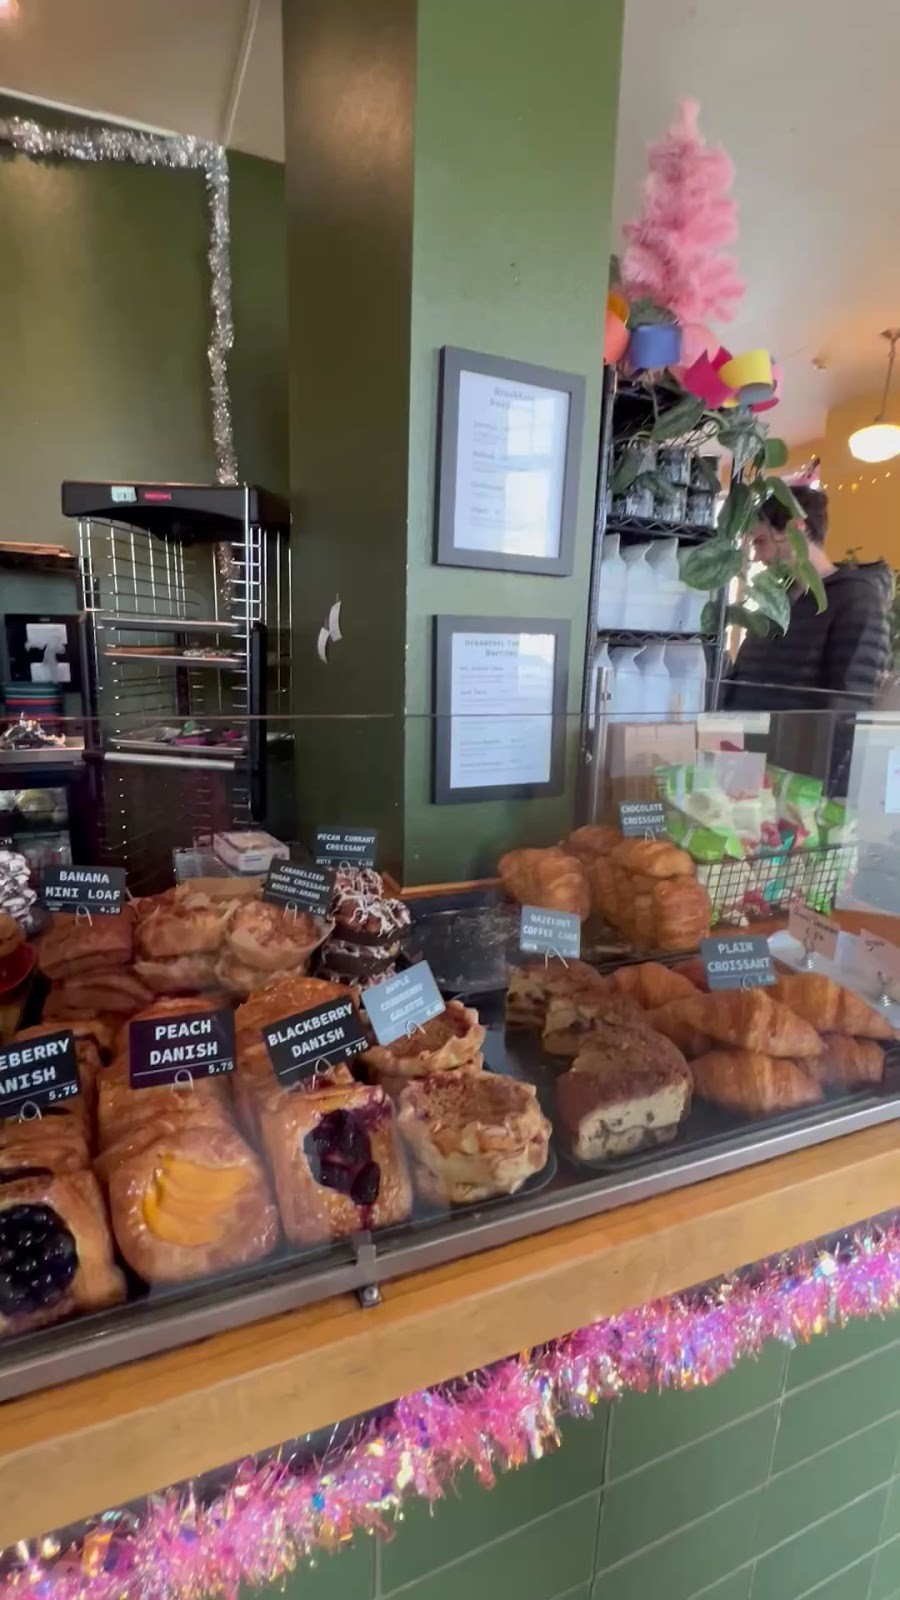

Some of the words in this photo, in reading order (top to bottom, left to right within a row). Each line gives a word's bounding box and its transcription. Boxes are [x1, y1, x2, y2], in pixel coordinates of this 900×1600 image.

[621, 803, 664, 814] CHOCOLATE
[623, 814, 666, 826] CROISSANT
[317, 833, 340, 841] PECAN
[325, 843, 367, 852] CROISSANT
[59, 870, 110, 884] BANANA
[45, 886, 79, 899] MINI
[87, 889, 121, 901] LOAF
[717, 941, 754, 954] PLAIN
[707, 957, 770, 973] CROISSANT
[155, 1019, 212, 1041] PEACH
[267, 1003, 353, 1047] BLACKBERRY
[291, 1026, 345, 1058] DANISH
[344, 1040, 369, 1056] 5.75
[149, 1041, 219, 1066] DANISH
[207, 1061, 235, 1075] 5.75
[48, 1083, 79, 1101] 5.75
